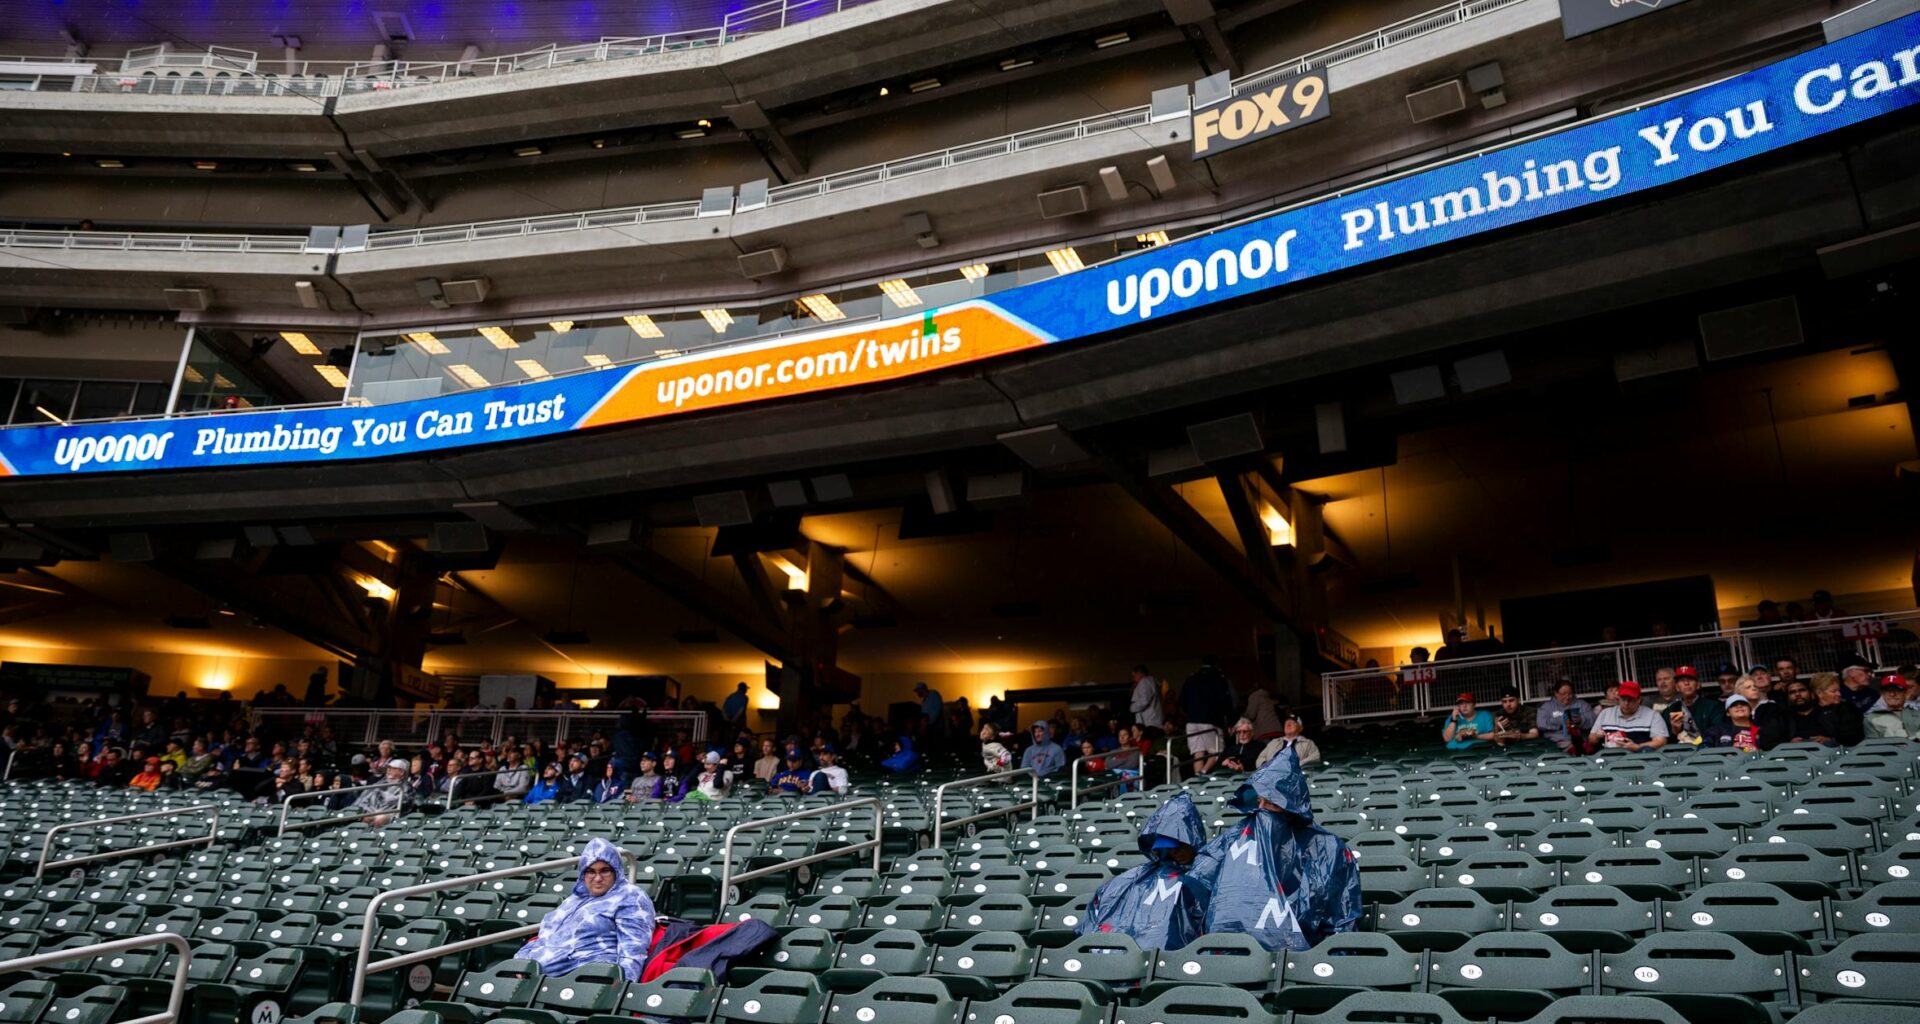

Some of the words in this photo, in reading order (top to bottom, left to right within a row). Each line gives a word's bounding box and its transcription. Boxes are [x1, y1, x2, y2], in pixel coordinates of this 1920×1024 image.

[1194, 84, 1291, 153] FOX
[1293, 76, 1324, 119] 9
[1341, 146, 1621, 251] Plumbing
[1638, 100, 1774, 167] You
[1108, 230, 1297, 319] uponor
[657, 328, 961, 407] uponor.com/twins
[193, 421, 343, 455] Plumbing
[352, 418, 407, 447] You
[415, 410, 473, 440] Can
[484, 393, 566, 431] Trust
[55, 431, 174, 471] uponor
[1852, 621, 1884, 637] 113
[1412, 668, 1434, 681] 113
[1143, 878, 1183, 905] M
[1254, 898, 1302, 933] M
[1844, 975, 1858, 984] 11
[258, 1011, 273, 1023] M
